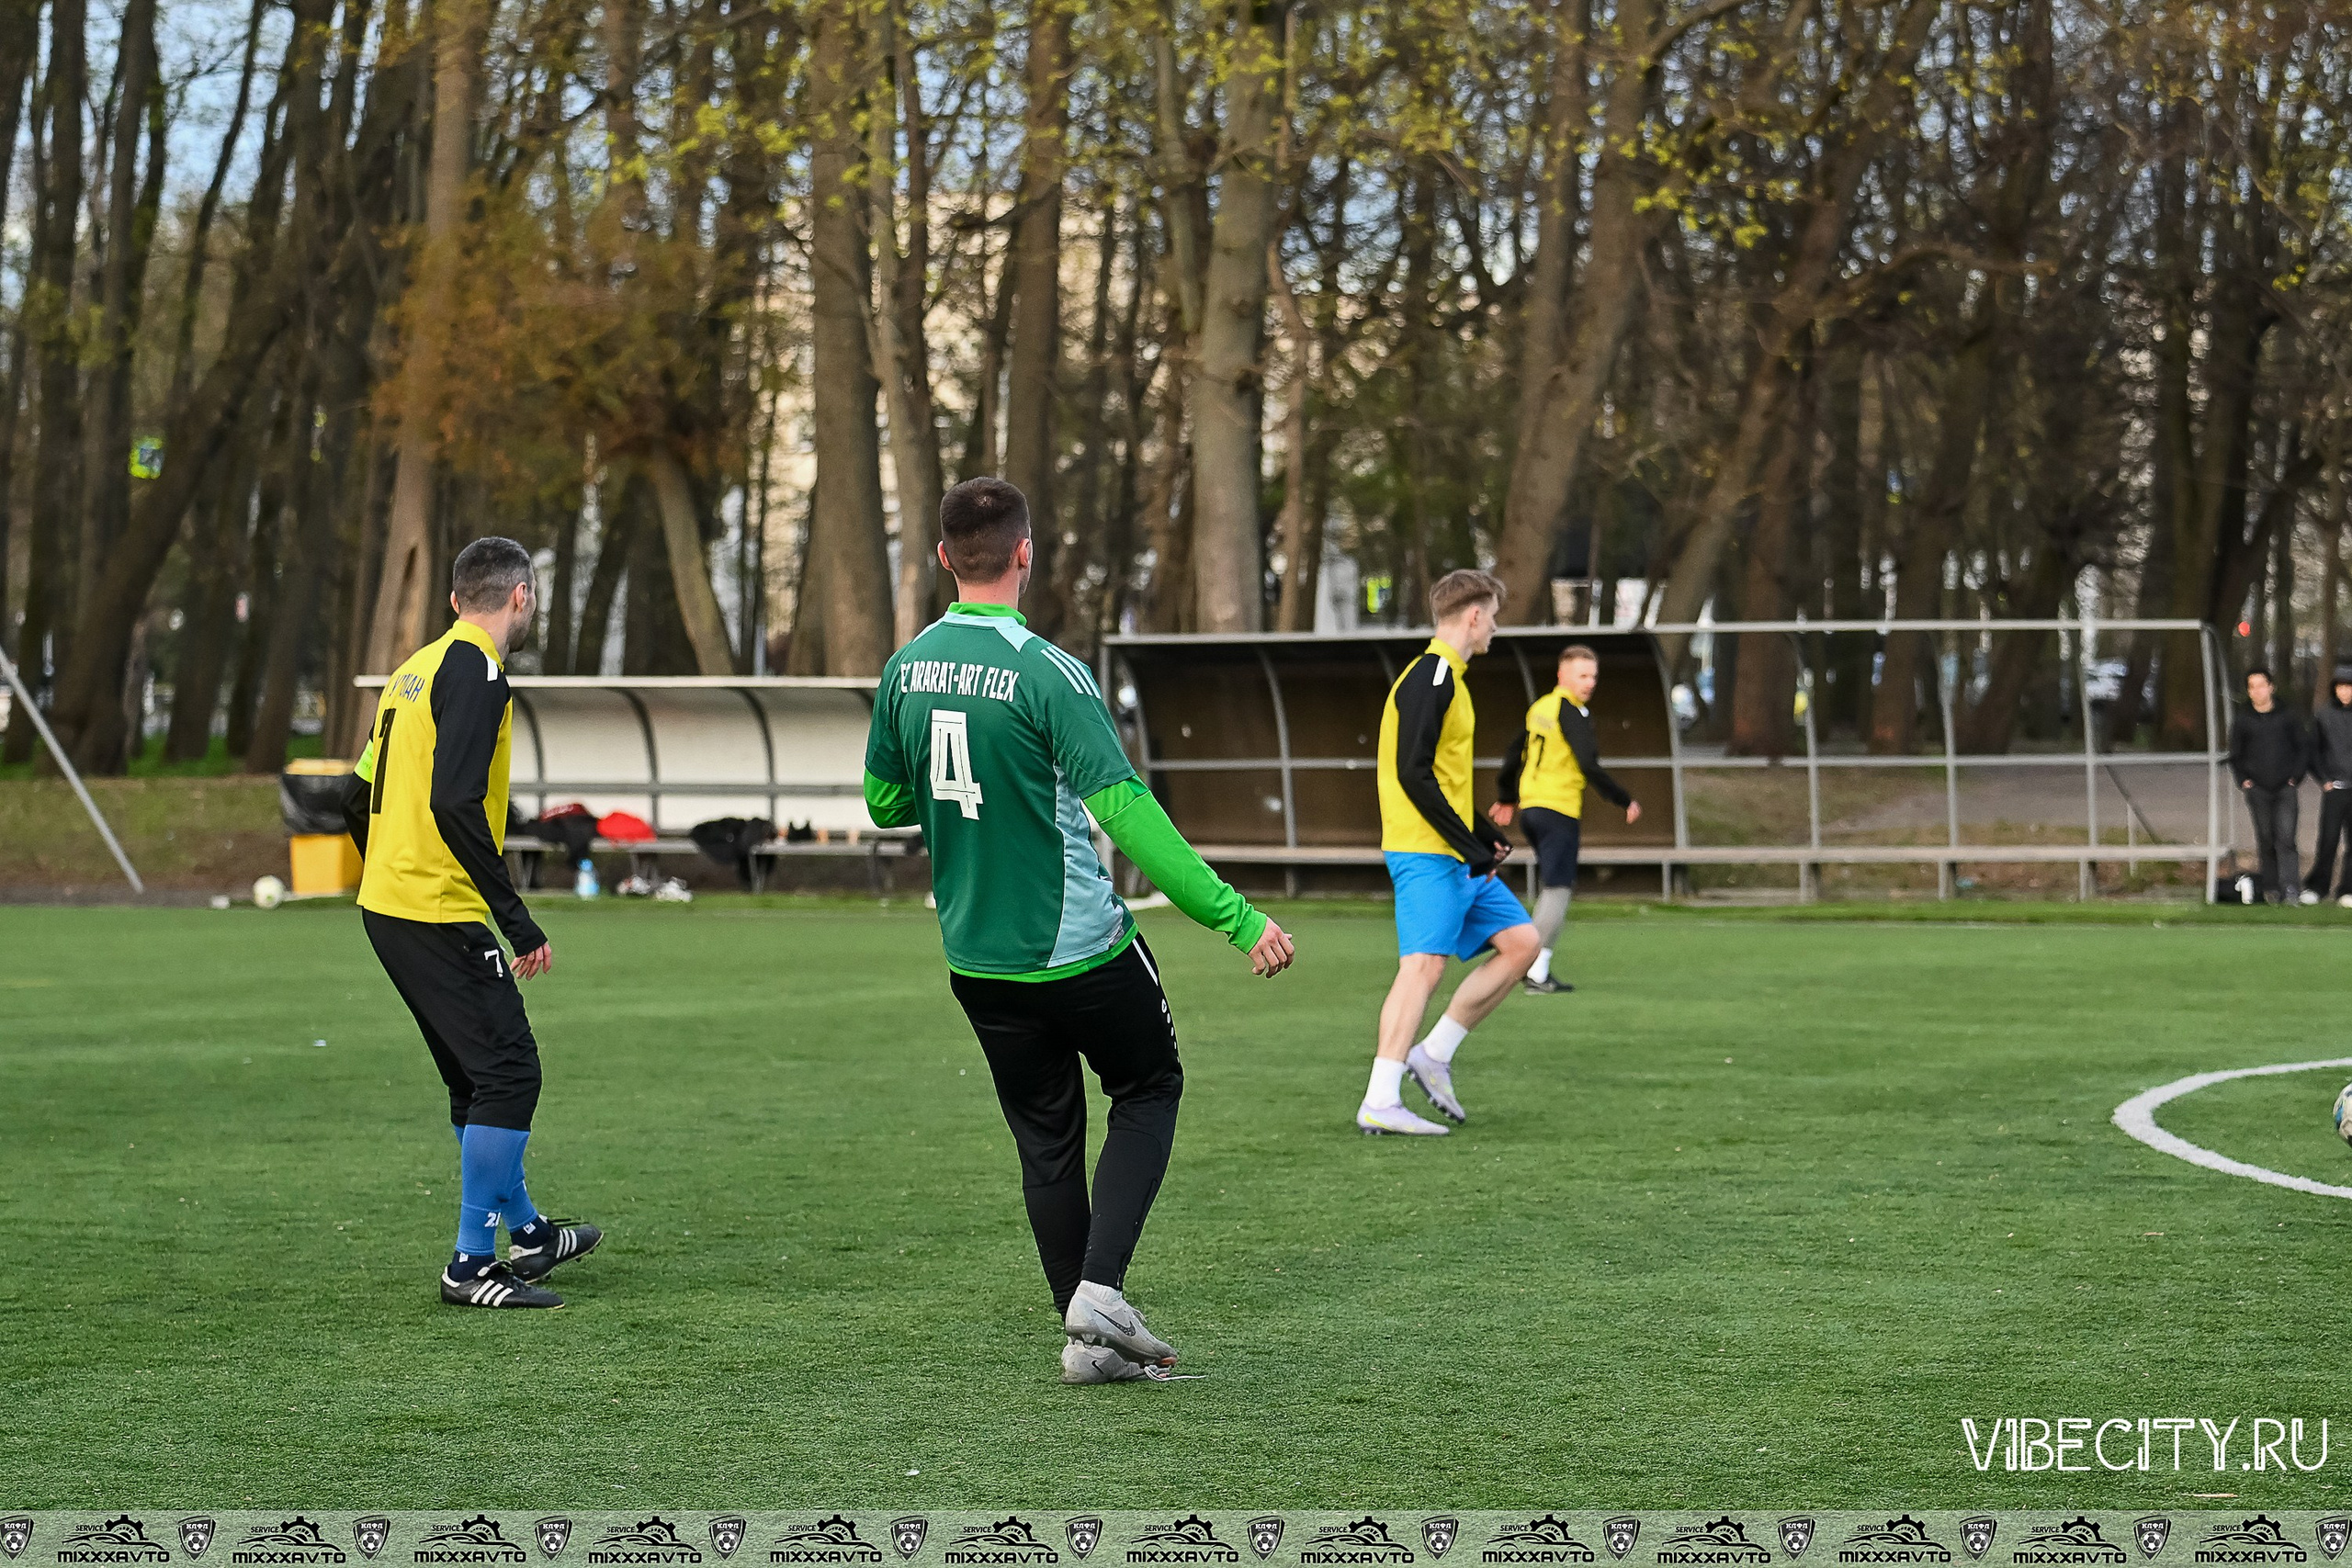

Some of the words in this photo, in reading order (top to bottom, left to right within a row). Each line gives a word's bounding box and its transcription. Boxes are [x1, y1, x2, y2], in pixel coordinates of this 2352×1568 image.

[910, 660, 984, 696] ARARAT-ART
[981, 666, 1020, 703] FLEX
[930, 708, 984, 821] 4
[483, 948, 503, 978] 7
